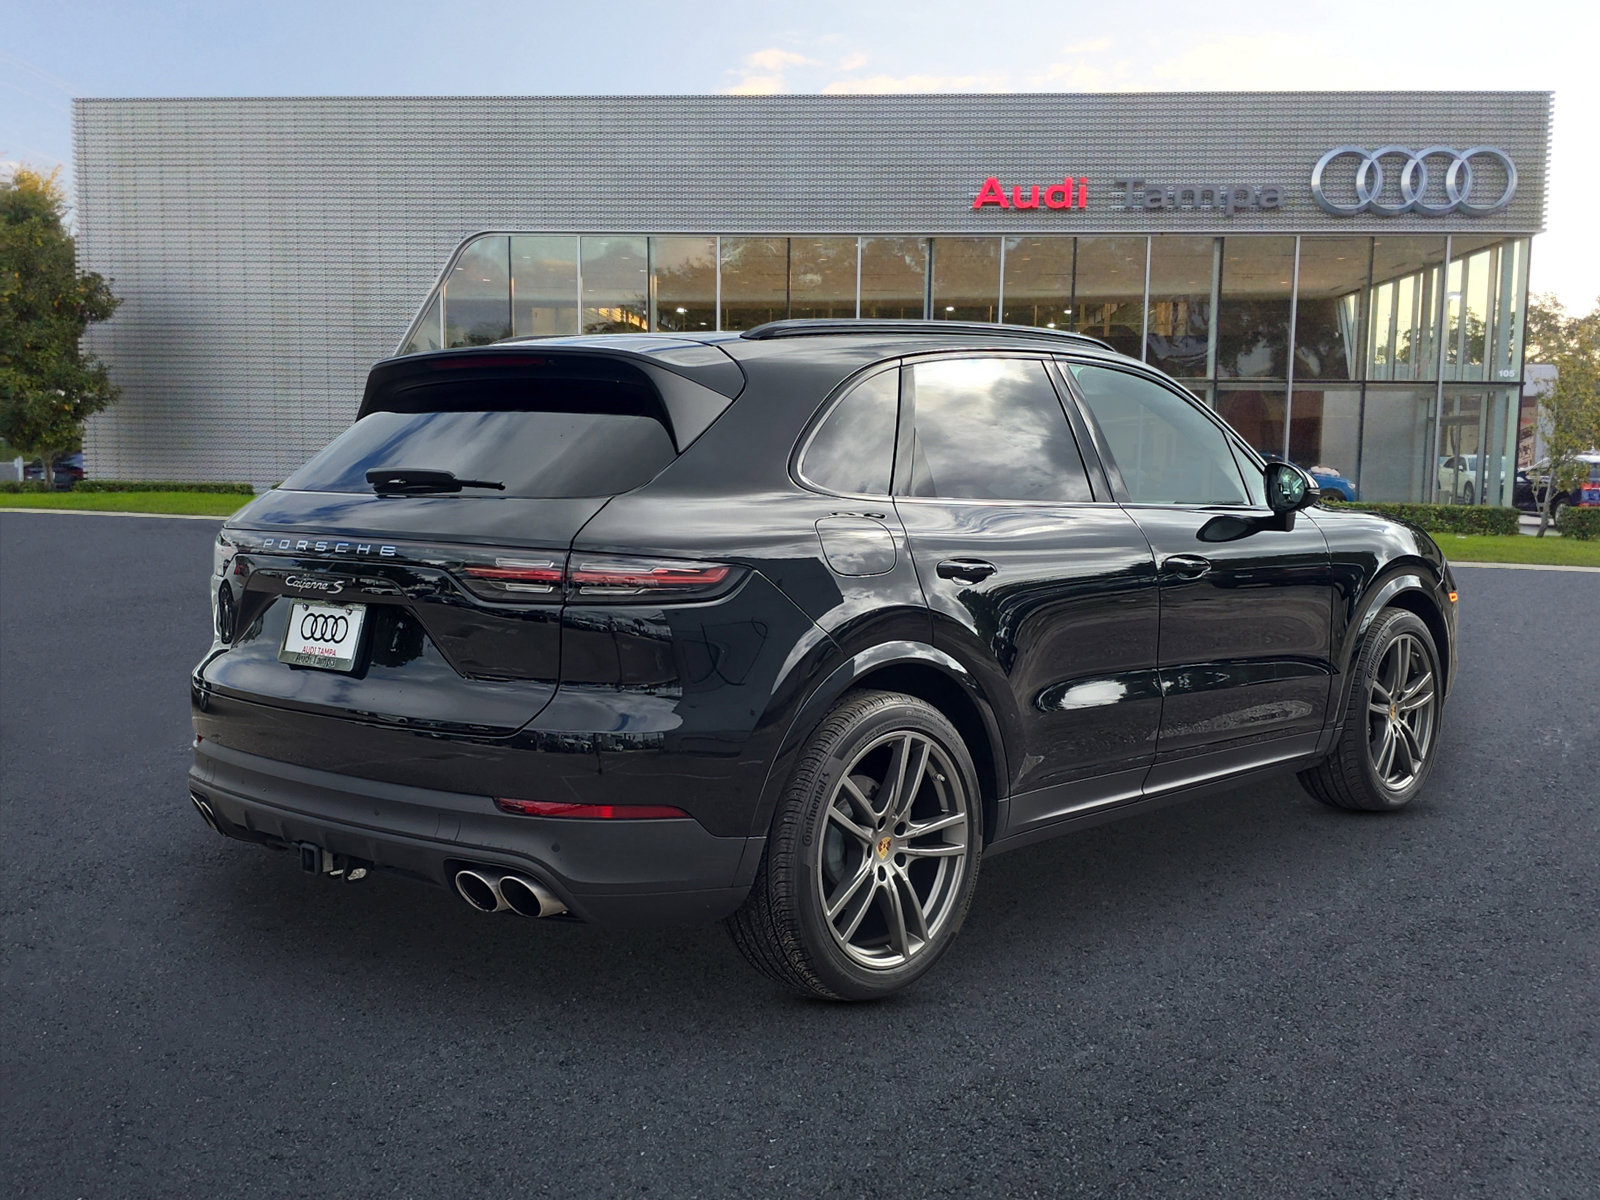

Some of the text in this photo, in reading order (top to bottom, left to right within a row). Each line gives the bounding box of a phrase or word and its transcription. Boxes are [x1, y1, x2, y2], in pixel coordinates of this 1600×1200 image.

[972, 177, 1285, 217] Audi Tampa
[1498, 369, 1515, 378] 105
[263, 538, 396, 557] PORSCHE
[285, 575, 345, 594] Cayenne S
[302, 646, 336, 656] AUDI TAMPA
[802, 780, 827, 847] Continental
